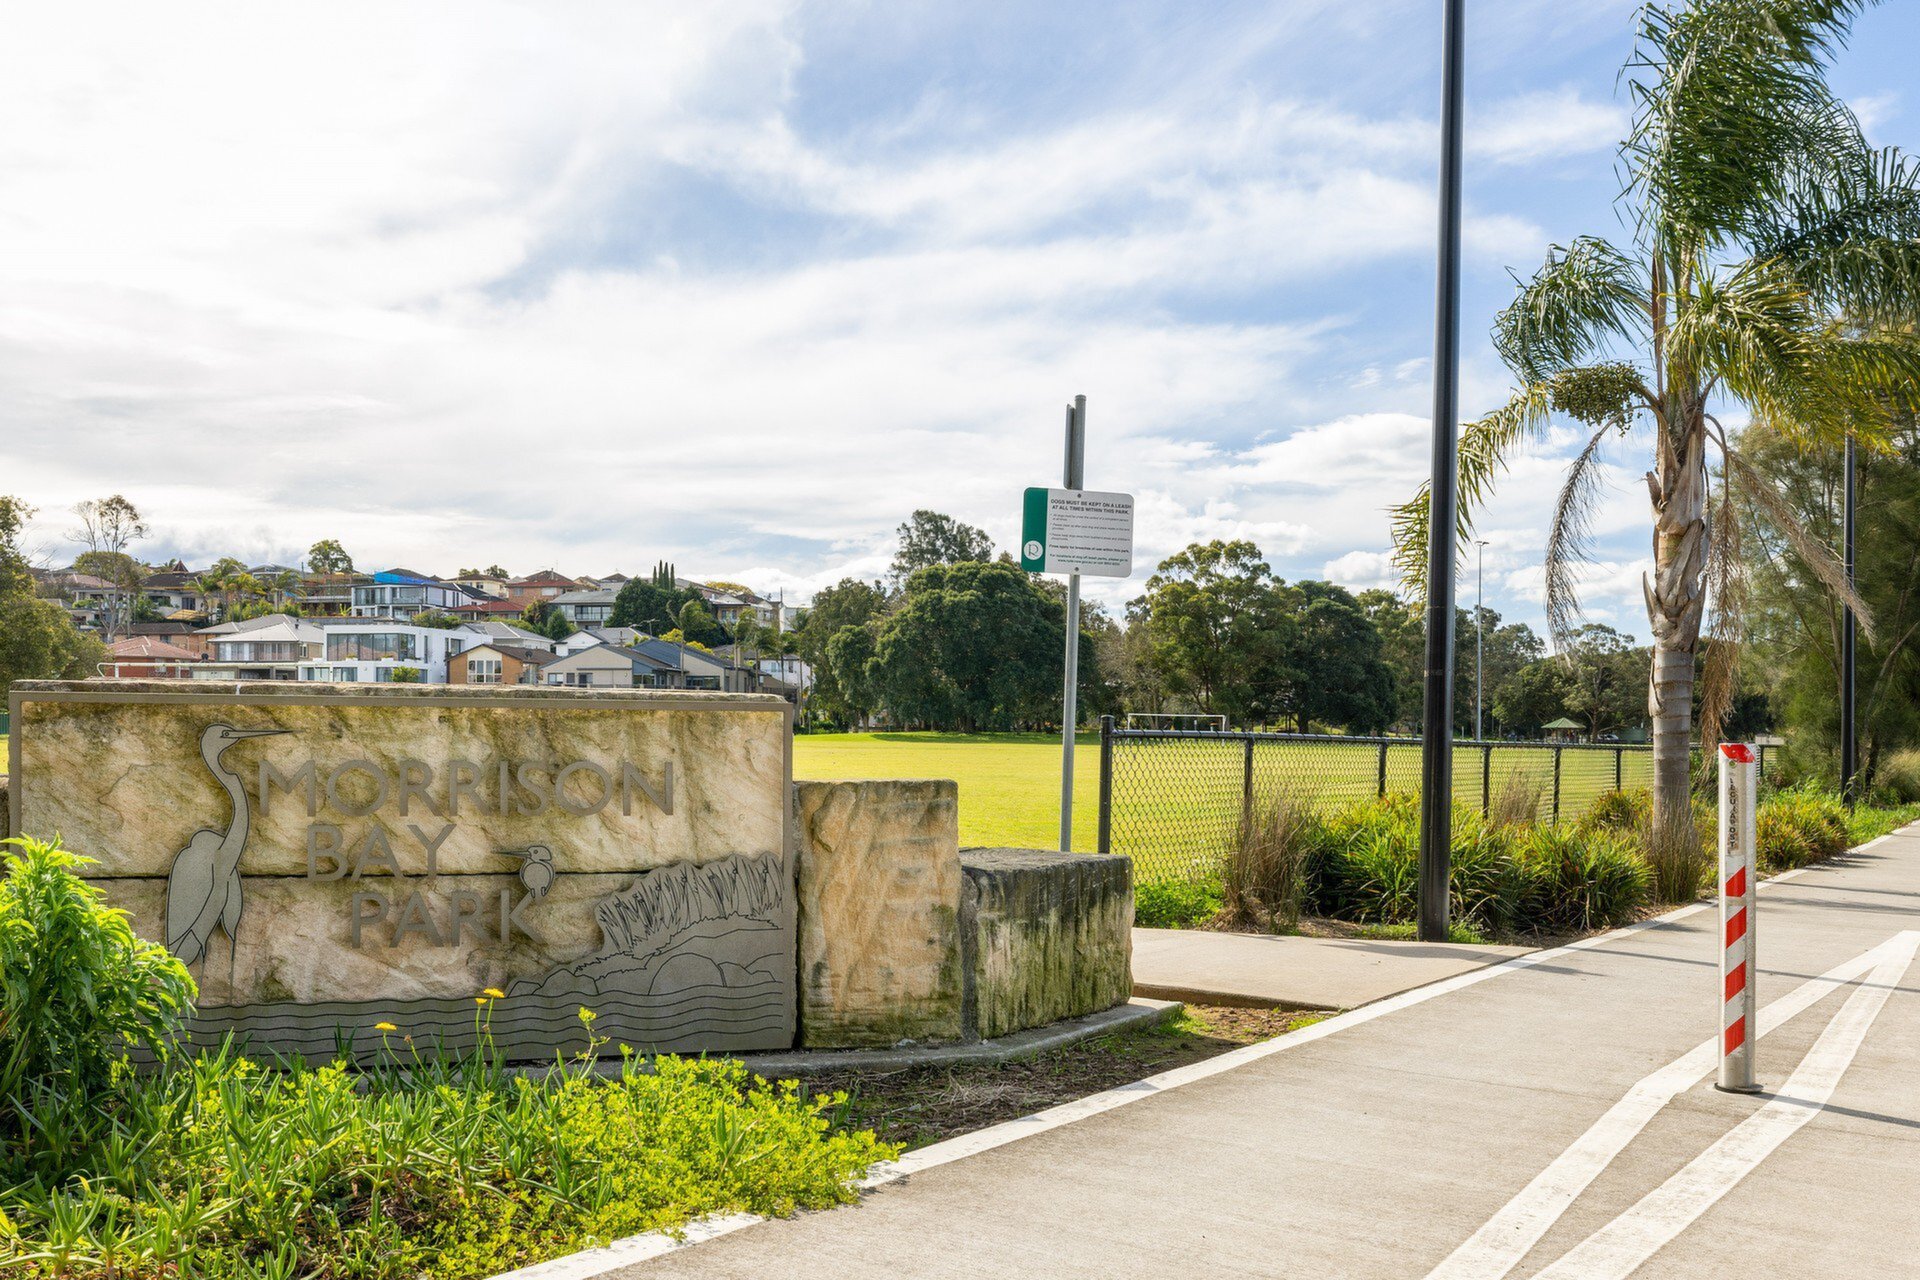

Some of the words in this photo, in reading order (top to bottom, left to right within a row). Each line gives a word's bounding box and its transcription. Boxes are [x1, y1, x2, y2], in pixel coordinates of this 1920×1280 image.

[258, 760, 674, 818] MORRISON
[307, 823, 457, 883] BAY
[350, 890, 546, 949] PARK
